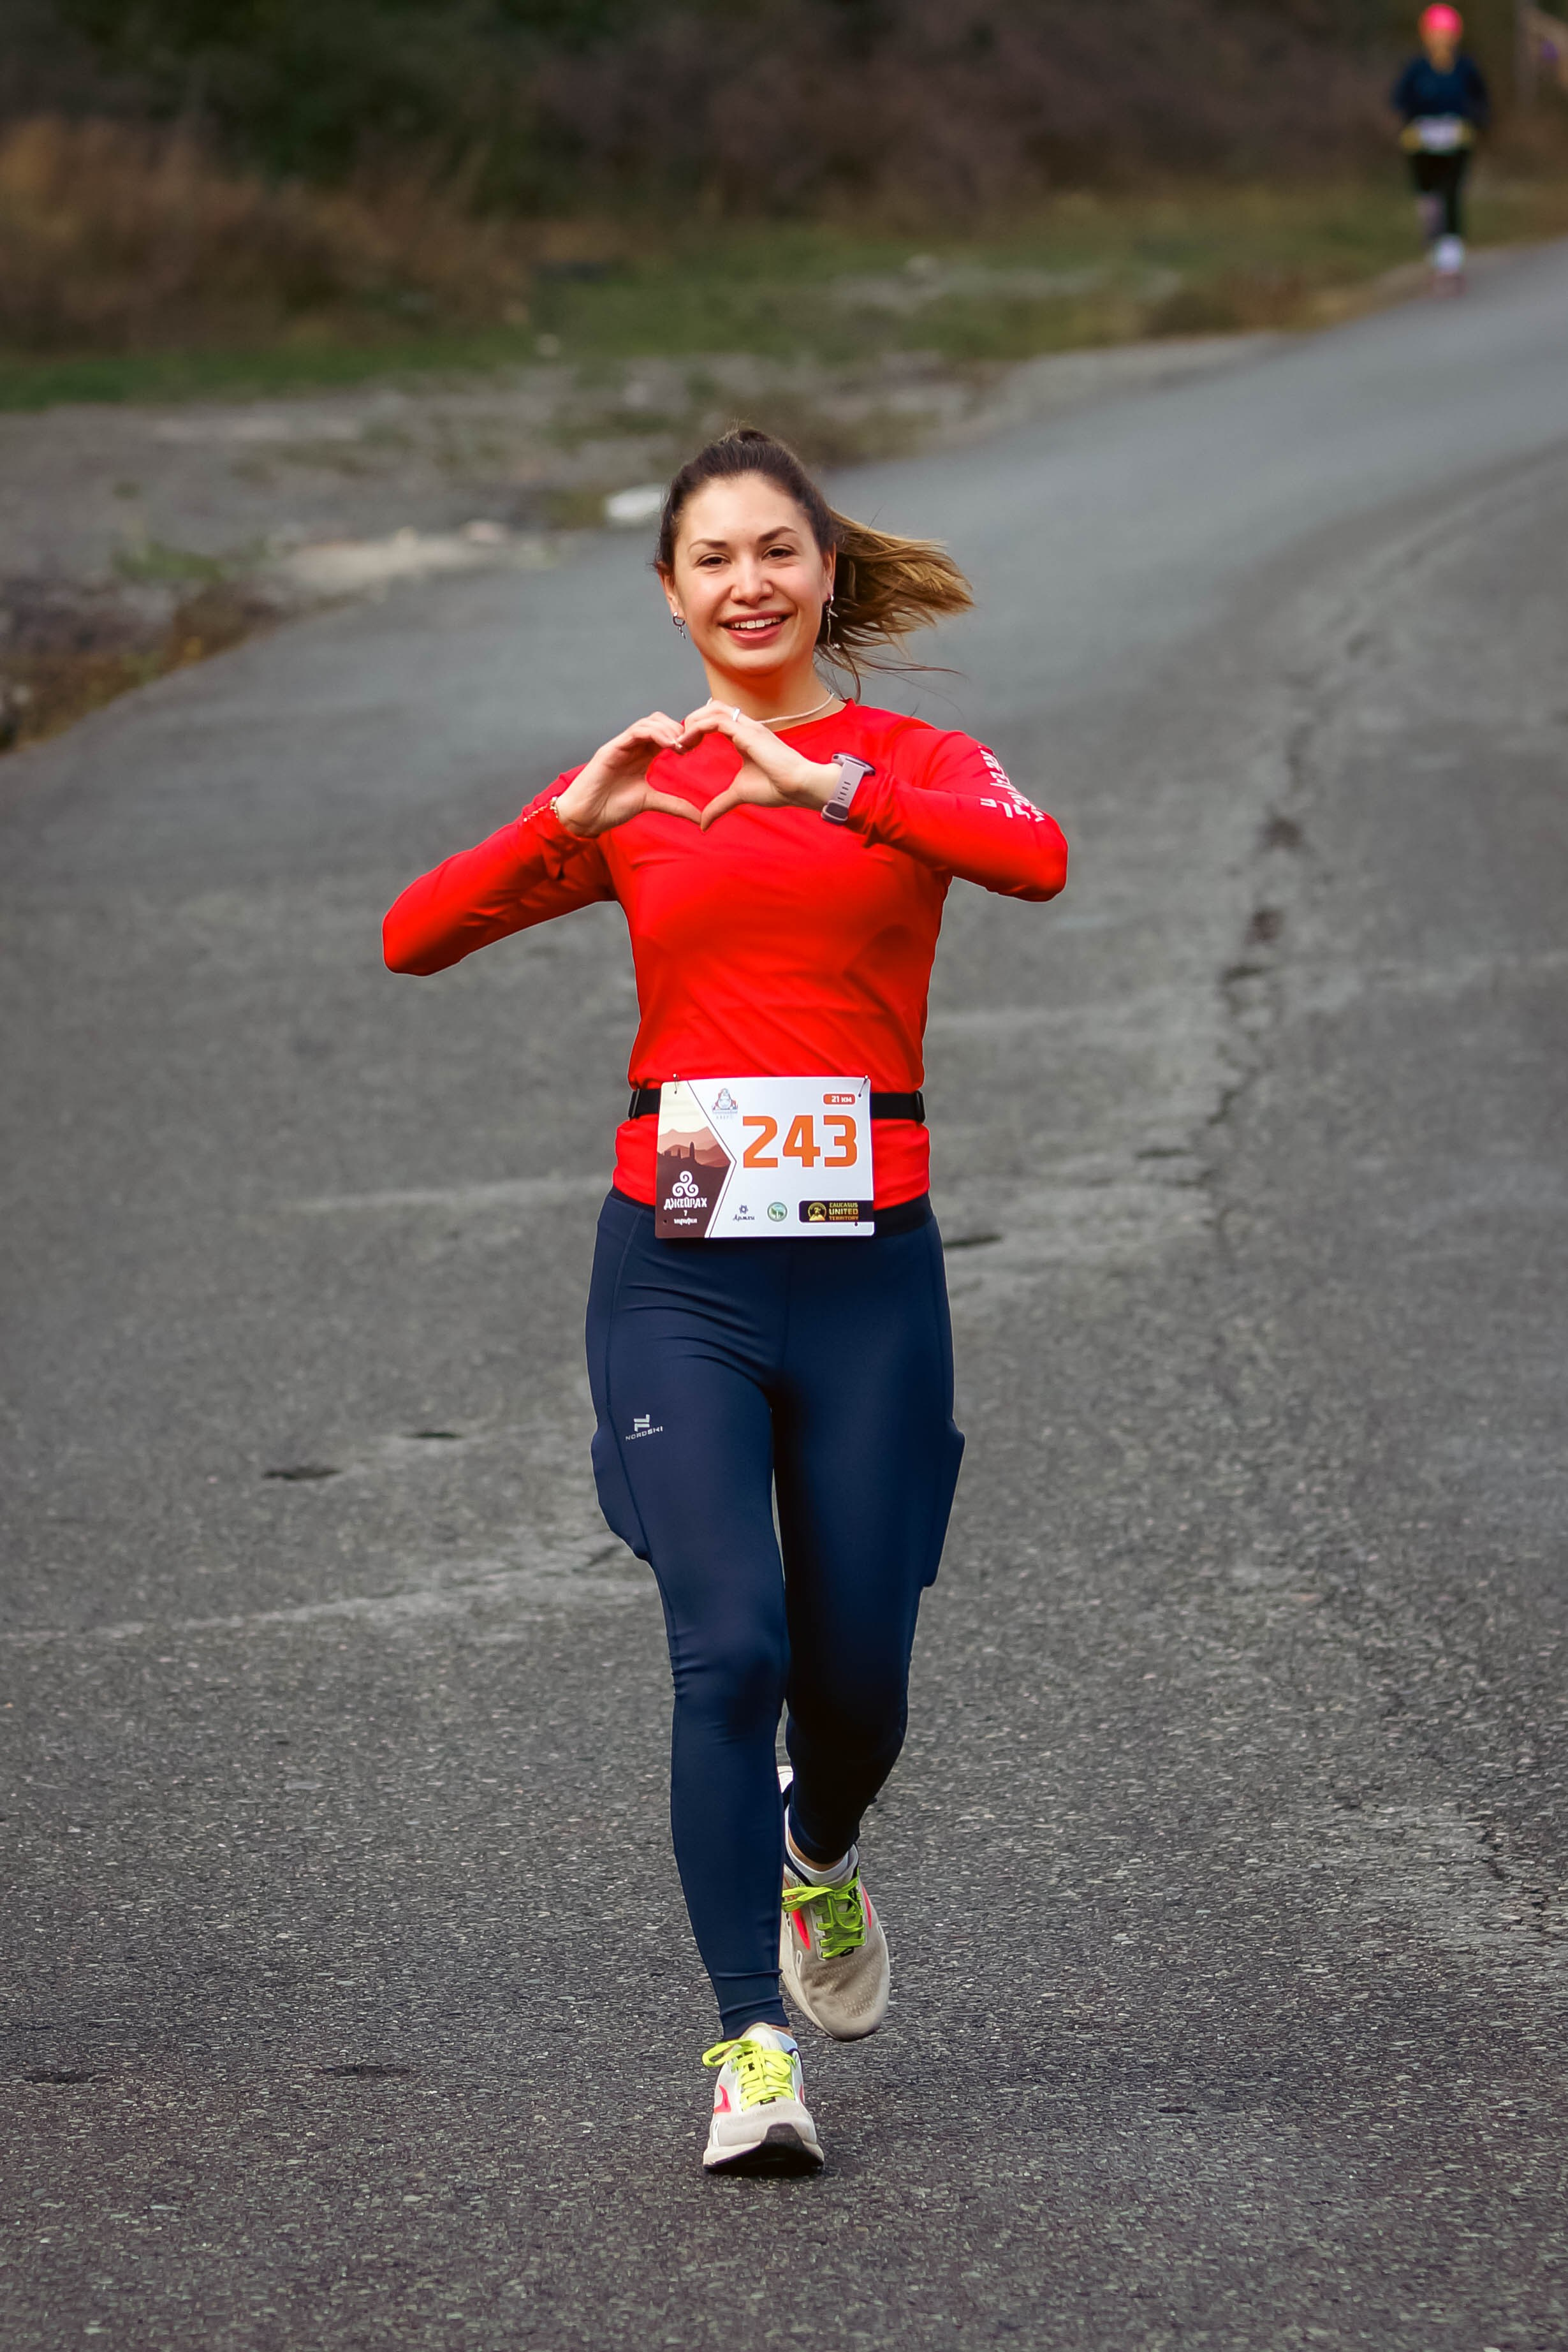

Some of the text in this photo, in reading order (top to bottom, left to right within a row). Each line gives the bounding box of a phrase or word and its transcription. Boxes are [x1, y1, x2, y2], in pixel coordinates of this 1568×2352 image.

[742, 1115, 858, 1168] 243
[663, 1196, 707, 1210] ДЖЕЙРАХ
[625, 1425, 663, 1441] NORDSKI
